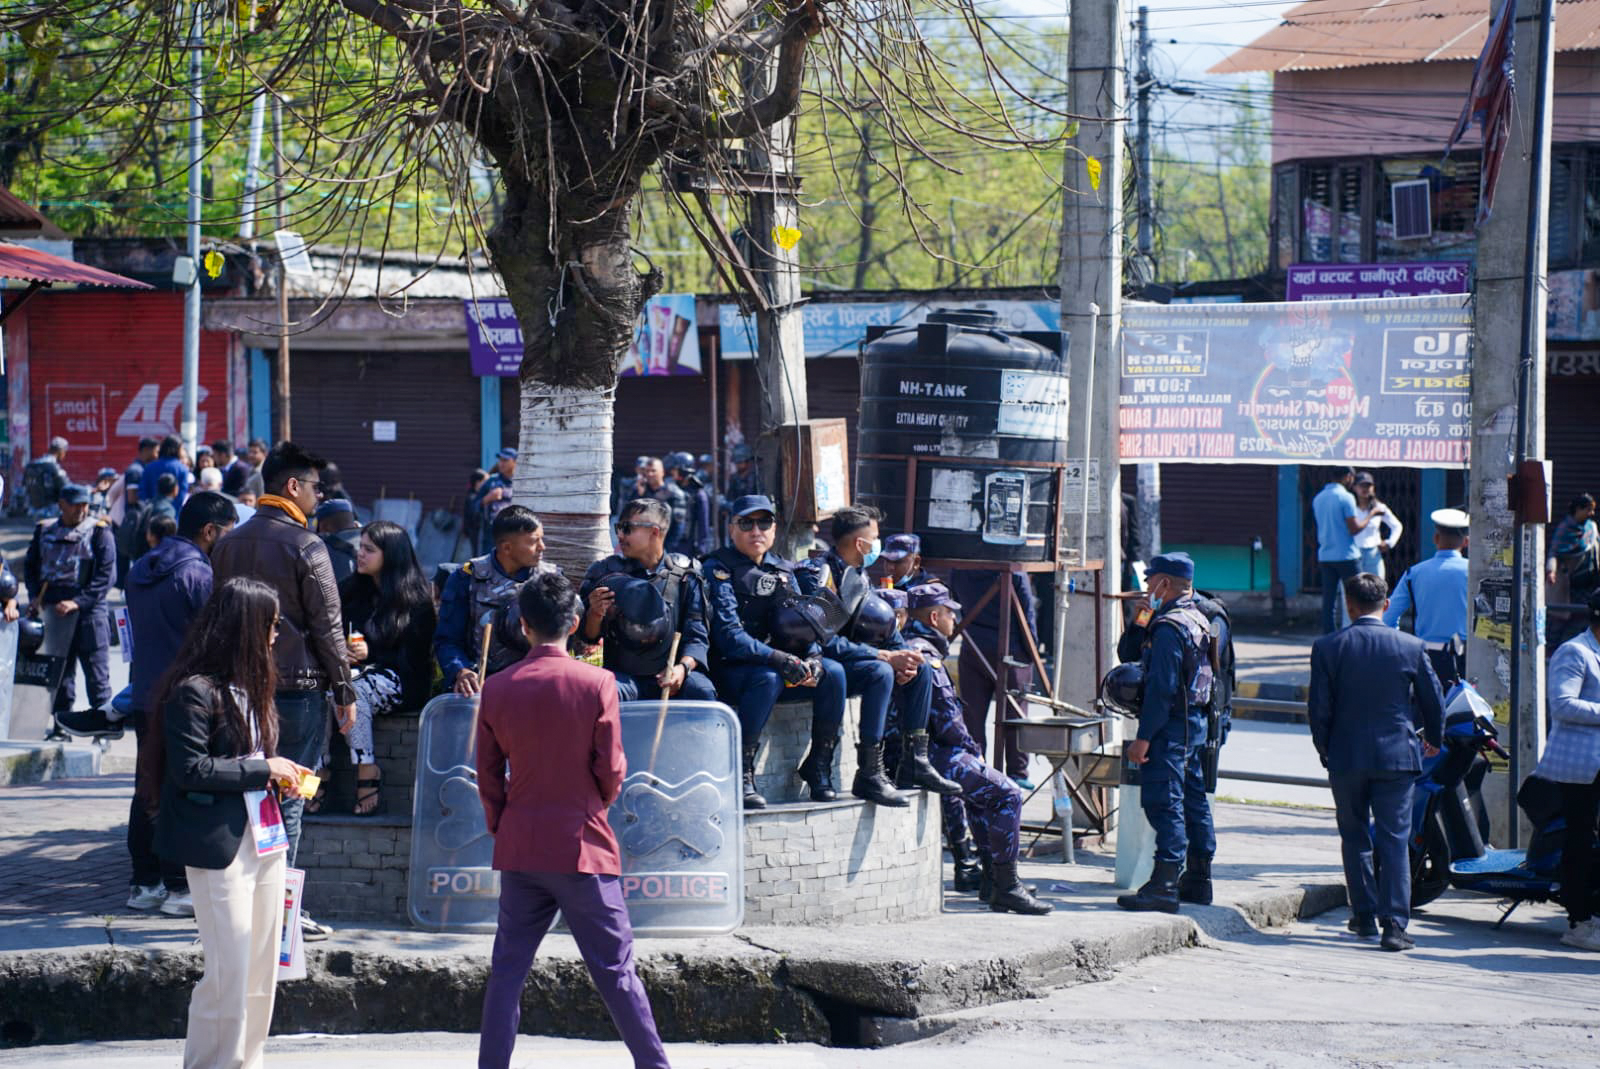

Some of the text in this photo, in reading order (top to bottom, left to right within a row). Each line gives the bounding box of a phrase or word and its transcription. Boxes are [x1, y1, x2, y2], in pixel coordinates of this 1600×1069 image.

[900, 381, 968, 397] NH-TANK
[53, 399, 98, 415] smart
[66, 417, 98, 432] cell
[896, 412, 915, 425] EXTRA
[916, 412, 938, 426] HEAVY
[622, 876, 725, 898] POLICE
